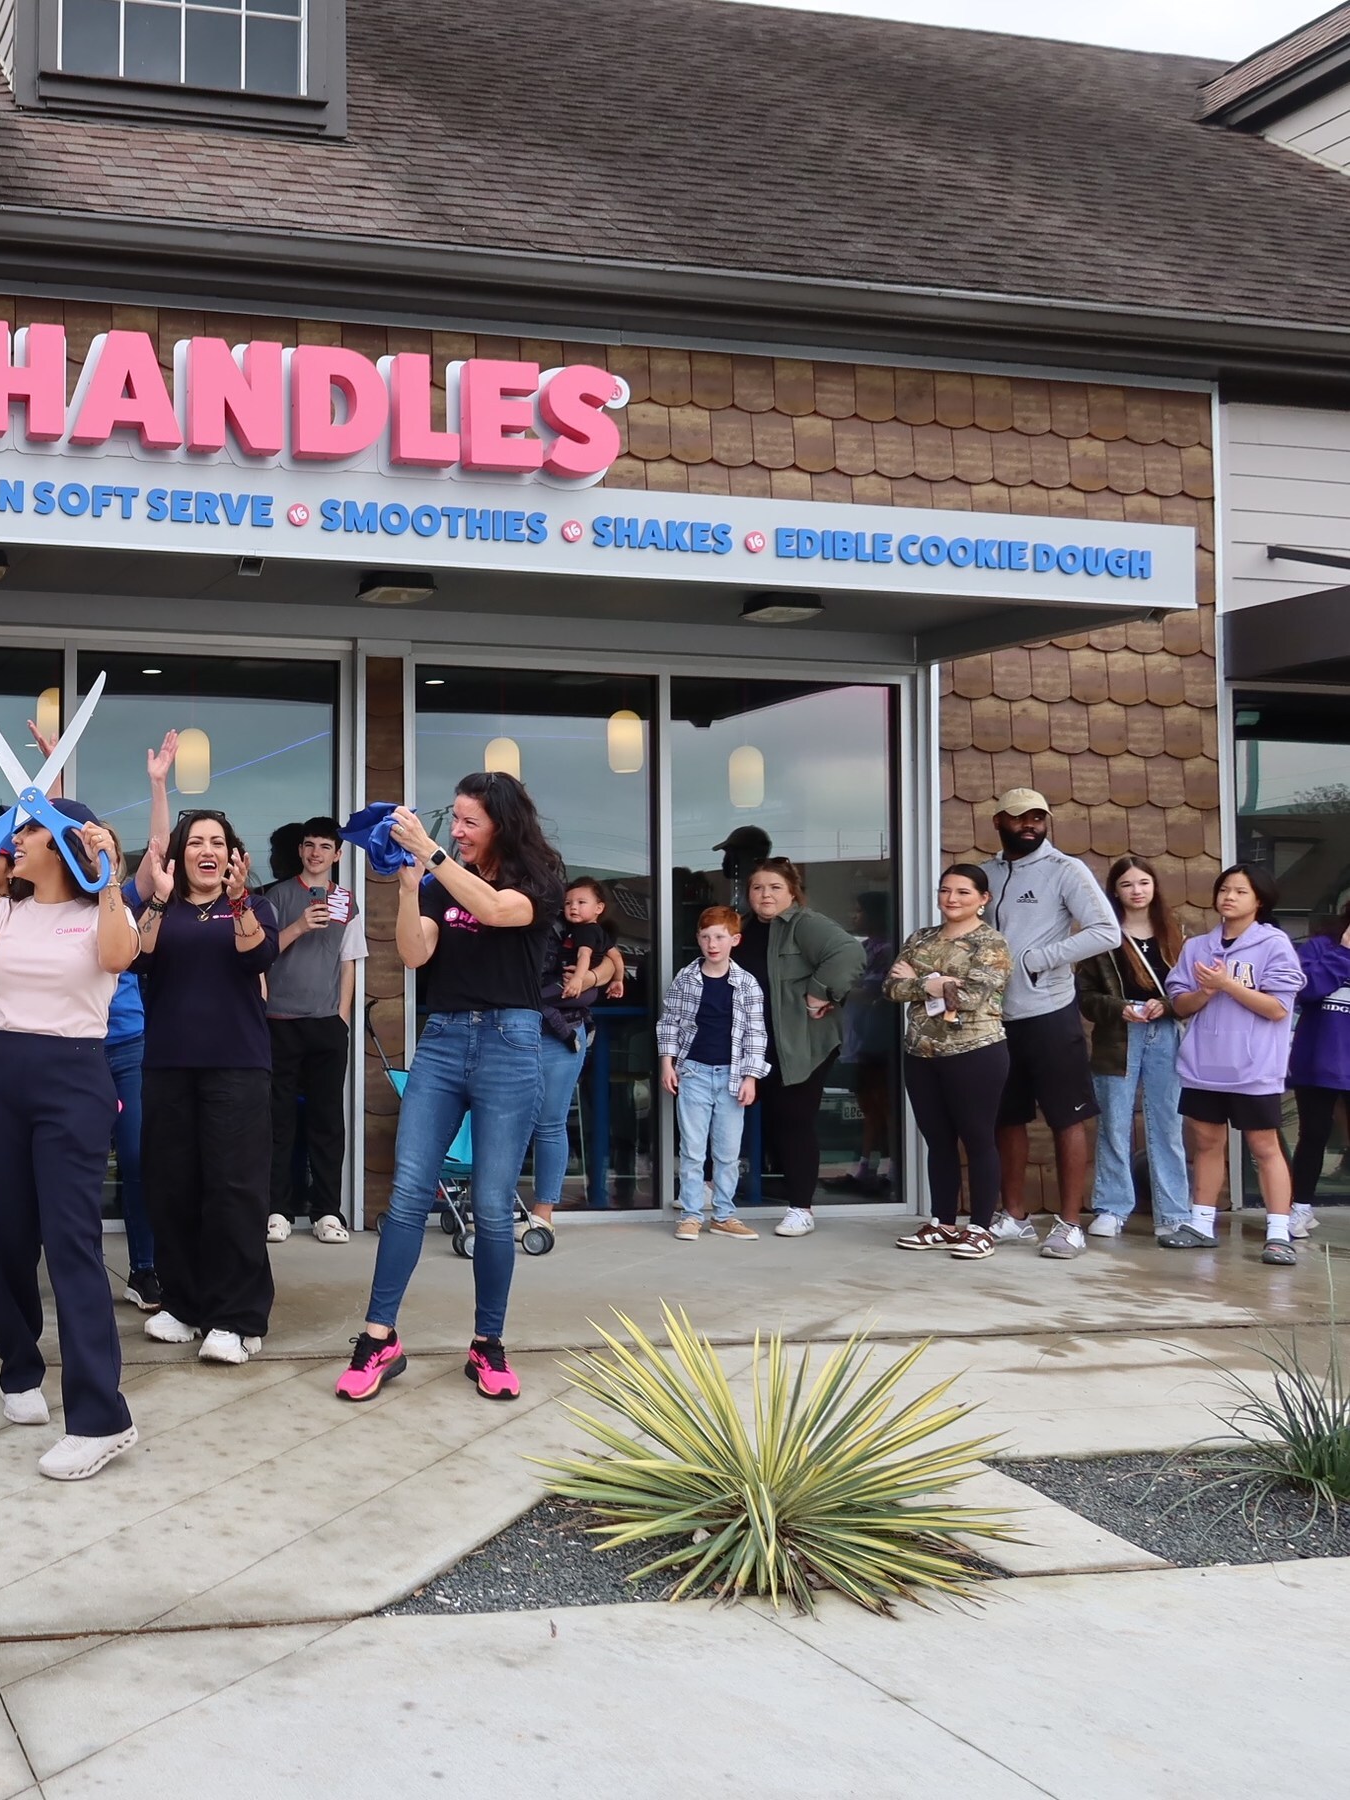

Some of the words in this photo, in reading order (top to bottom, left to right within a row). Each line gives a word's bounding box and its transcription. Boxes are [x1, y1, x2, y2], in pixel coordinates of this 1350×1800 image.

[33, 481, 141, 520] SOFT
[146, 488, 274, 528] SERVE
[290, 505, 308, 522] 16
[320, 499, 548, 545] SMOOTHIES
[564, 522, 581, 539] 16
[592, 517, 733, 555] SHAKES
[747, 533, 764, 549] 16
[775, 527, 894, 564] EDIBLE
[897, 534, 1030, 571] COOKIE
[1033, 543, 1152, 580] DOUGH
[445, 909, 457, 919] 16
[1322, 1003, 1350, 1014] RIDG
